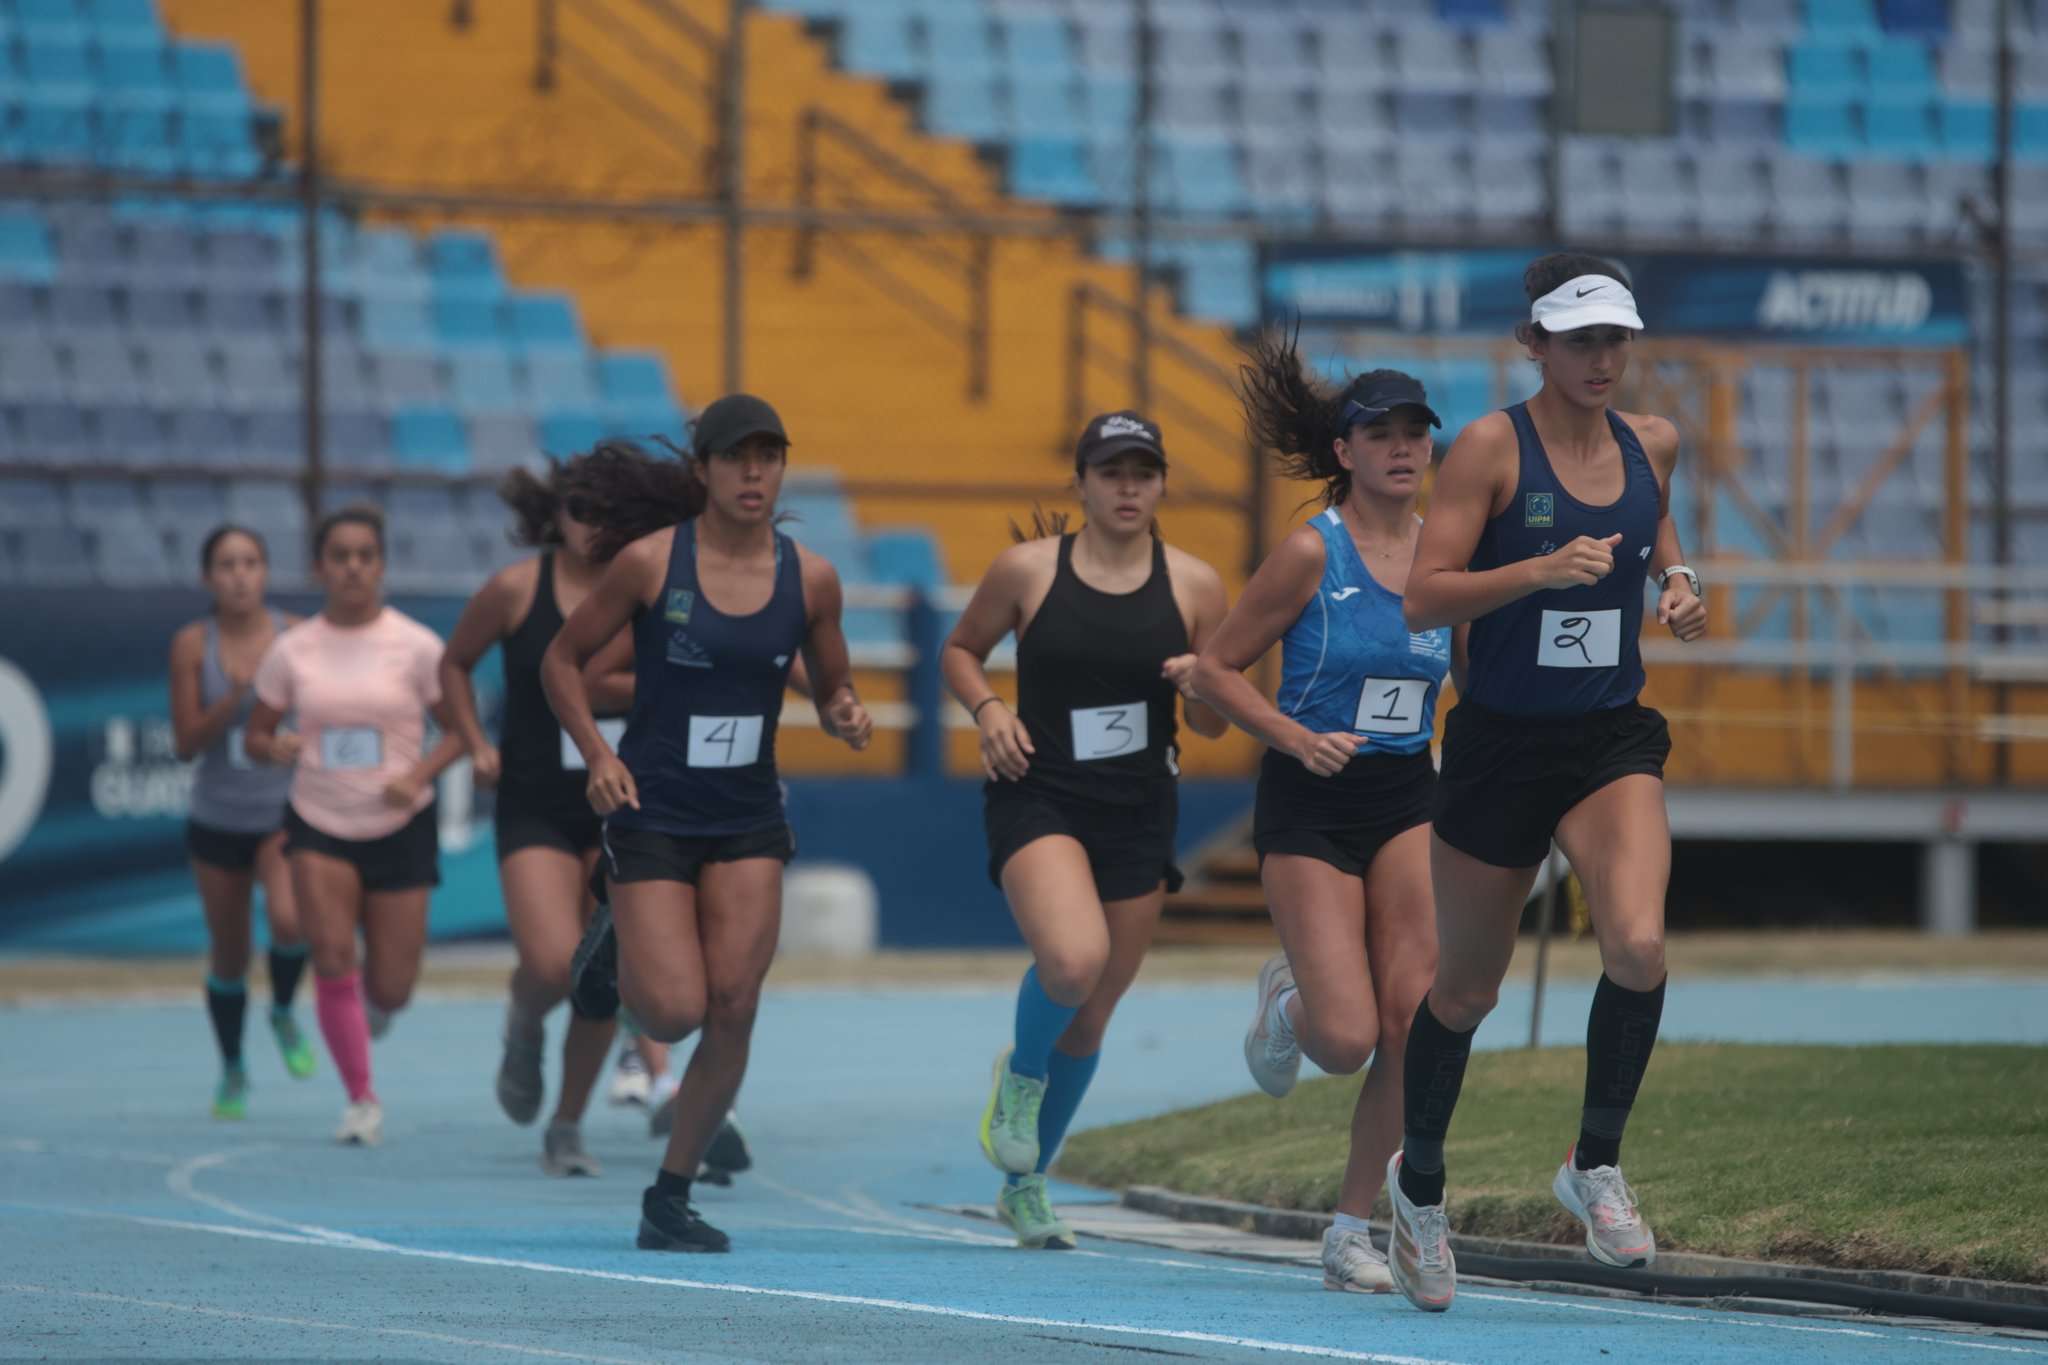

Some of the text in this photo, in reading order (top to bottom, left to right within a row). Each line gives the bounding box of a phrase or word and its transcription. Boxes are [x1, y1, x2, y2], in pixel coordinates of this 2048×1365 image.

[1553, 616, 1592, 664] 2
[1371, 686, 1409, 721] 1
[703, 719, 738, 765] 4
[1091, 709, 1134, 756] 3
